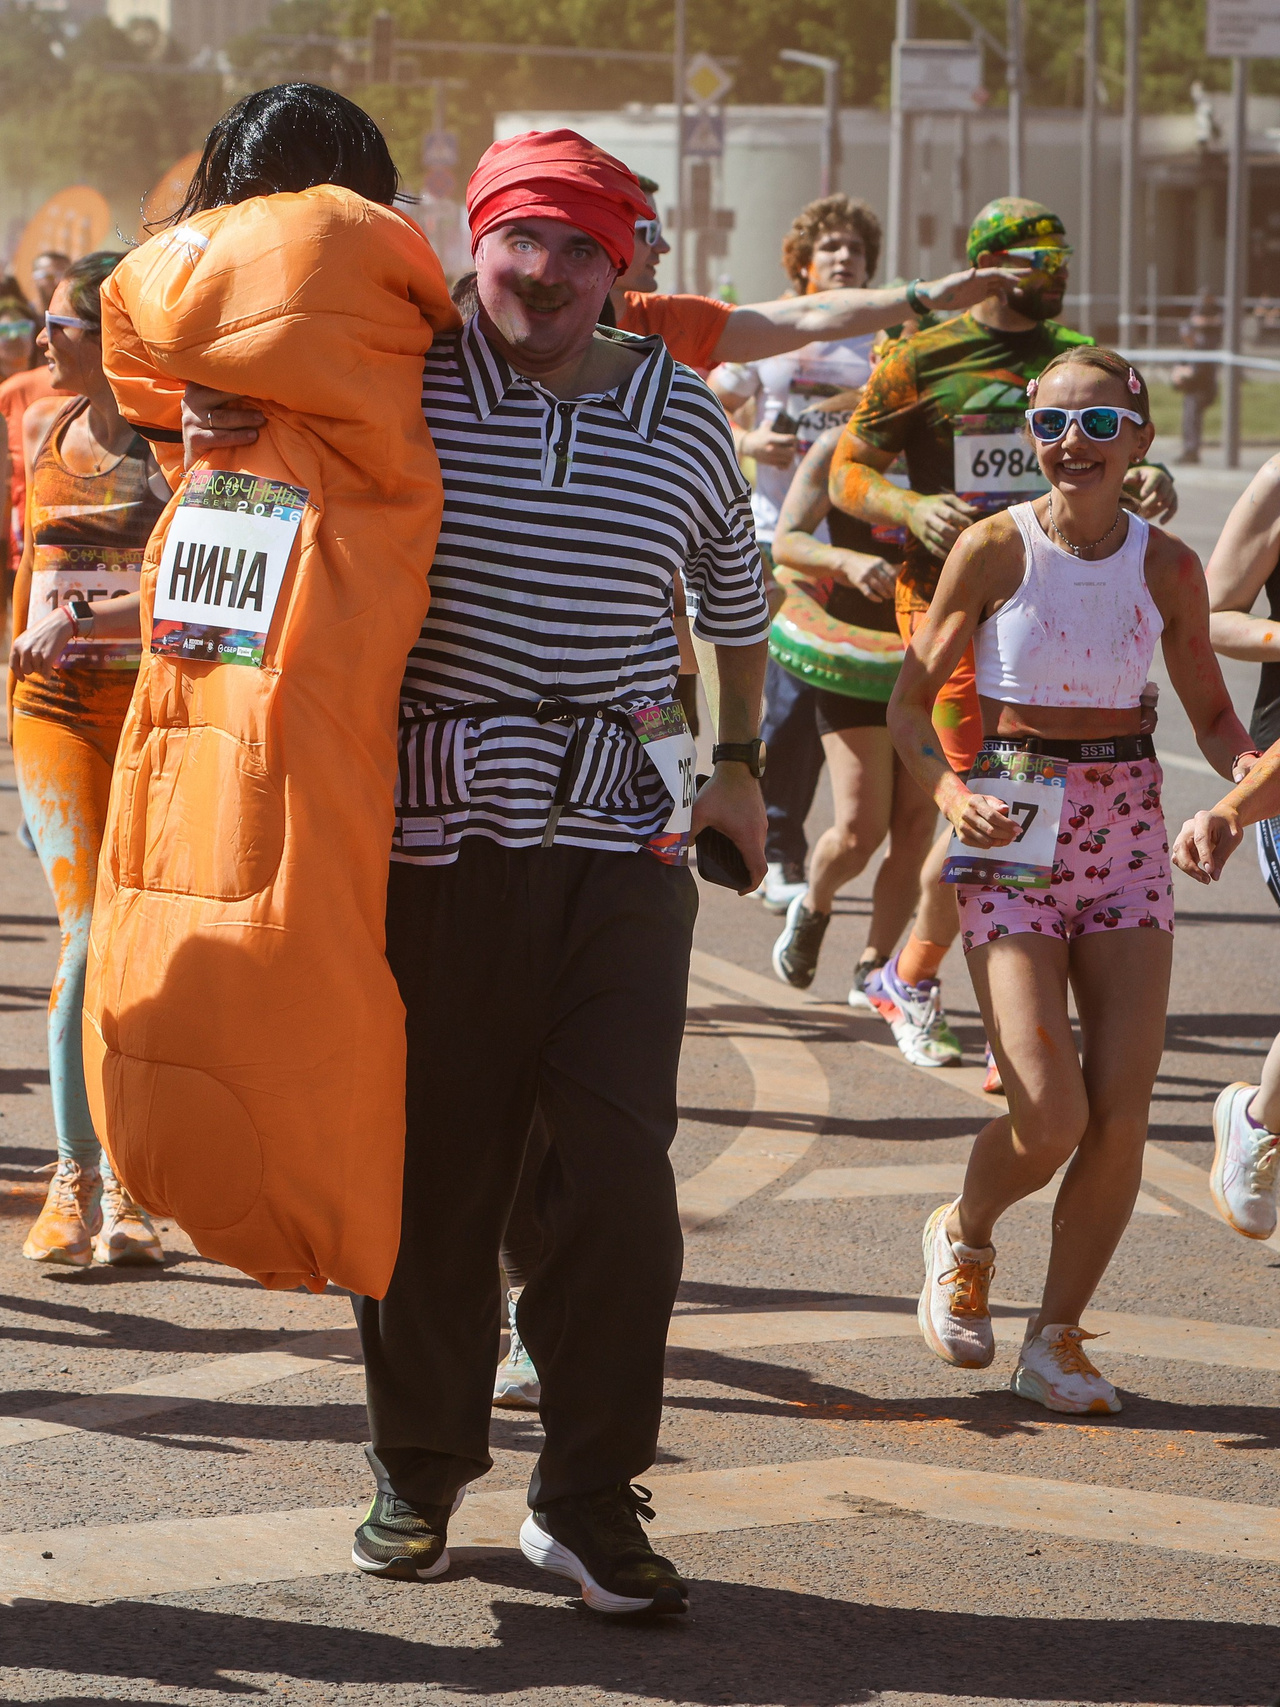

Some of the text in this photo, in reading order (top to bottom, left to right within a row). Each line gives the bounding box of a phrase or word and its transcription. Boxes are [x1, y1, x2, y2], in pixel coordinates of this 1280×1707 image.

[972, 447, 1043, 478] 6984
[187, 474, 299, 508] КРАСОЧНЫЙ
[236, 500, 302, 524] 2026
[96, 562, 137, 573] 202
[169, 541, 268, 612] НИНА
[999, 770, 1062, 788] 2026
